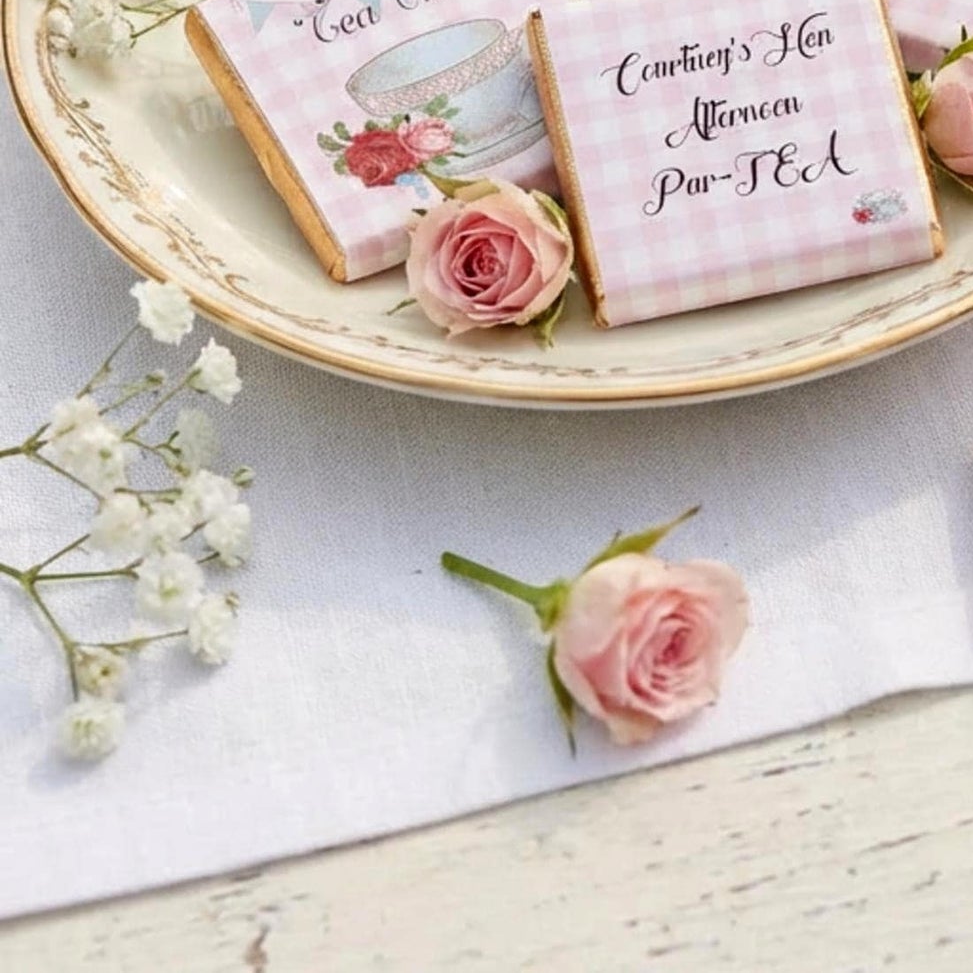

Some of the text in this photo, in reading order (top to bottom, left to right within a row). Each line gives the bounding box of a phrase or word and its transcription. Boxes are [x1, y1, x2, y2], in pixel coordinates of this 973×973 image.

[600, 12, 834, 96] Courtney's Hen
[664, 96, 803, 149] Afternoon
[643, 129, 858, 217] Par-TEA
